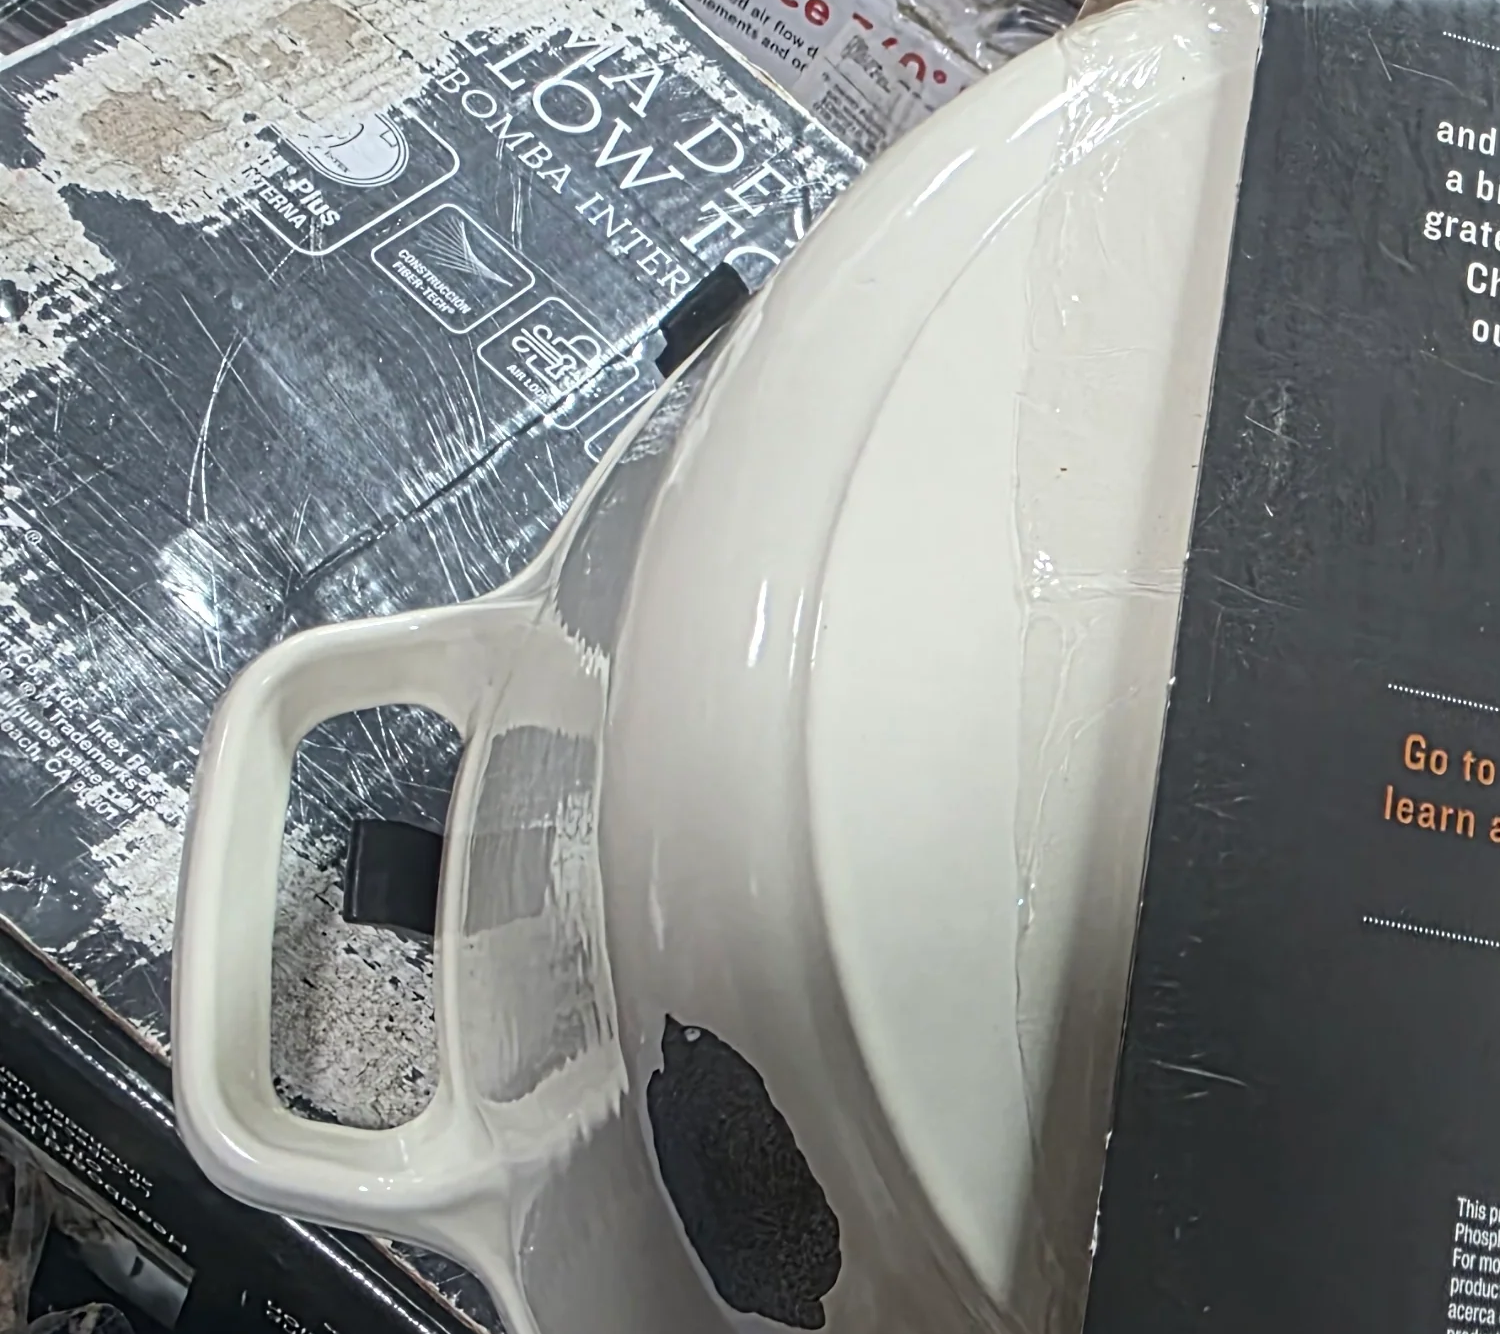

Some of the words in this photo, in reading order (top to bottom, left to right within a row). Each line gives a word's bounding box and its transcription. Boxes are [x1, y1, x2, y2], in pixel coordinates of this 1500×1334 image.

[437, 68, 571, 195] BOMBA
[1437, 121, 1497, 156] and
[1445, 170, 1463, 194] a
[49, 709, 138, 790] Trademarks
[87, 719, 129, 757] Intex
[1403, 734, 1448, 775] Go
[1463, 751, 1496, 785] to
[1384, 788, 1474, 835] learn
[1457, 1197, 1486, 1220] This
